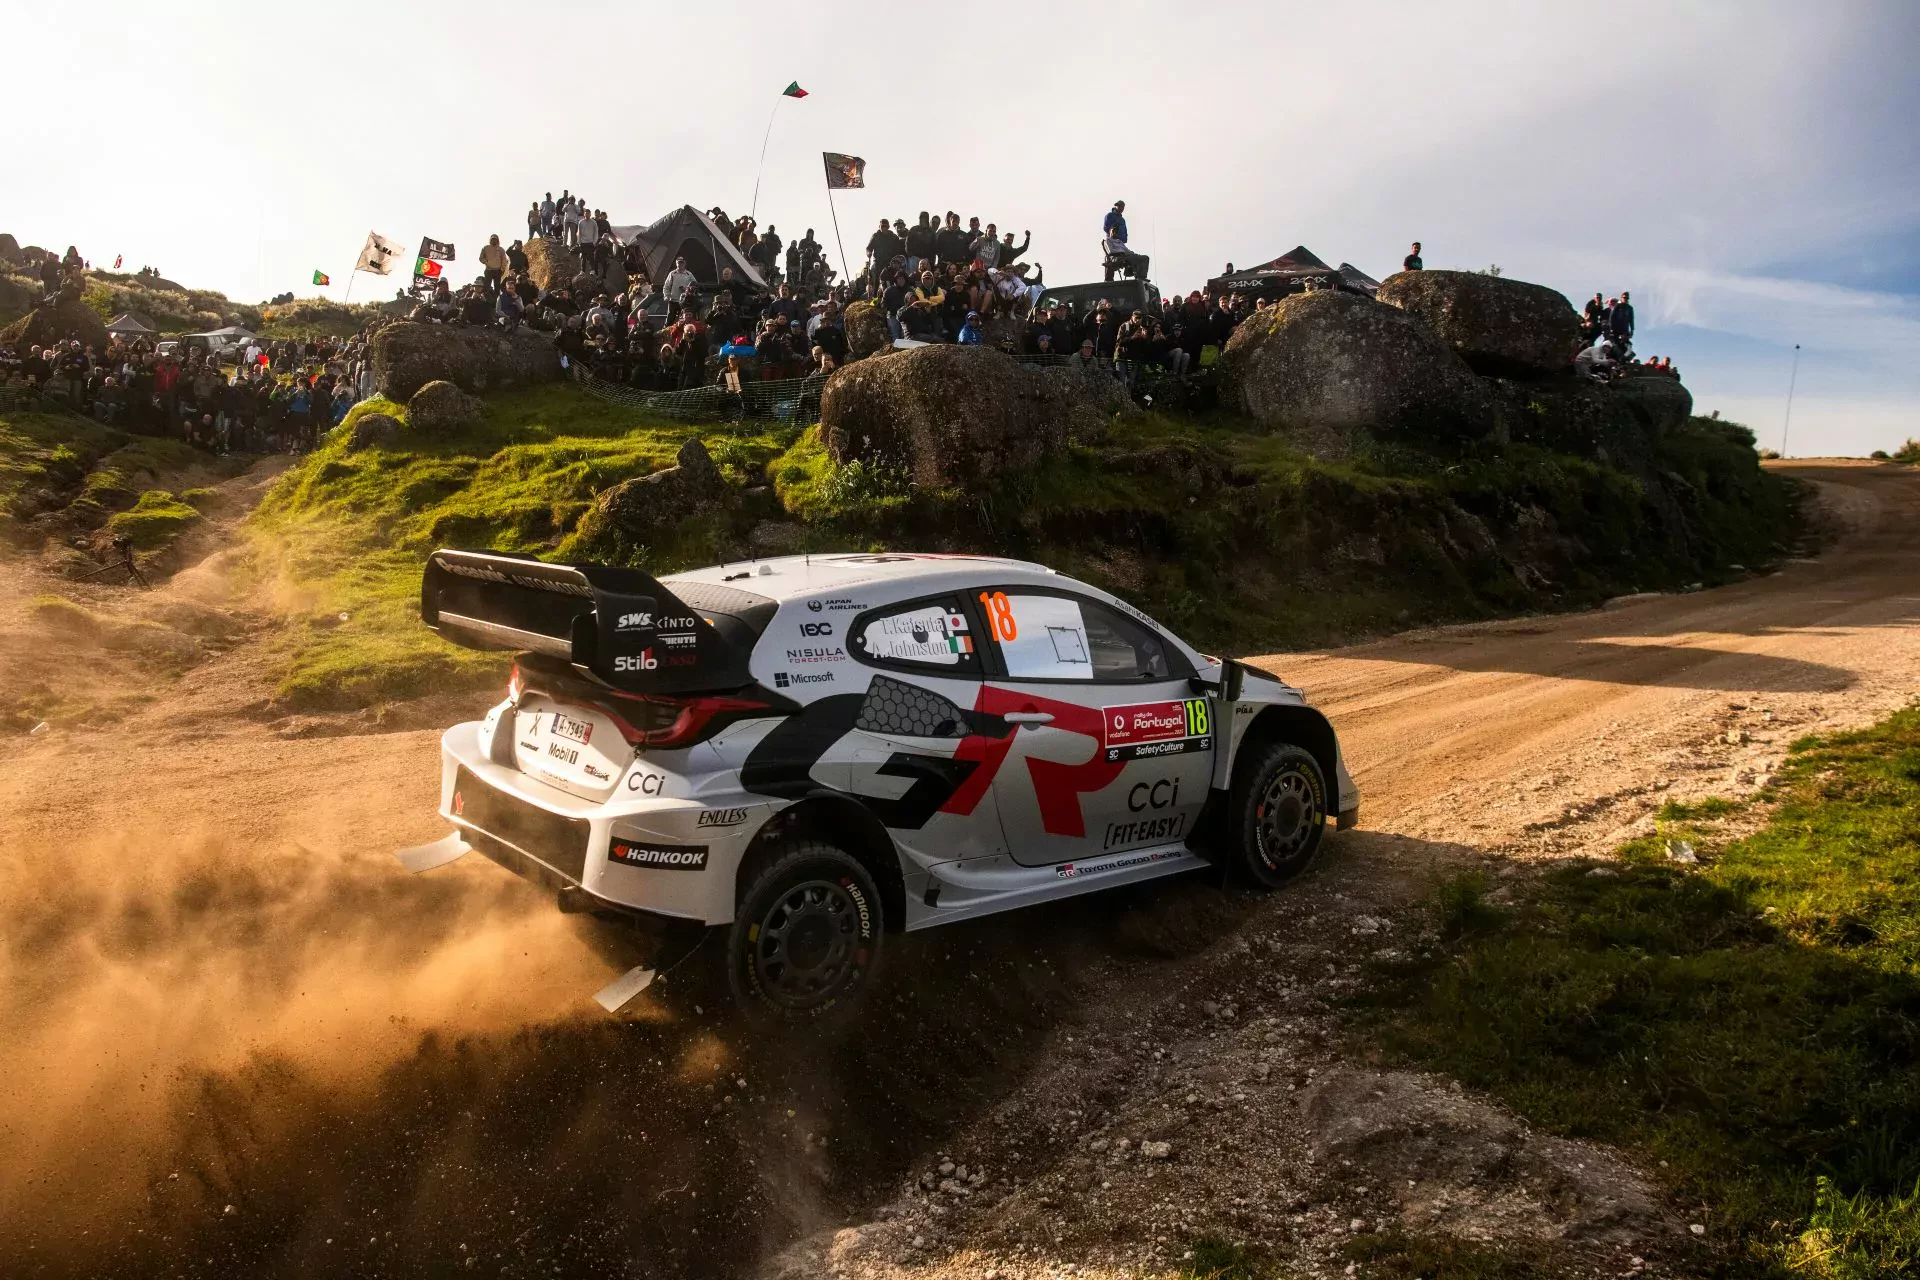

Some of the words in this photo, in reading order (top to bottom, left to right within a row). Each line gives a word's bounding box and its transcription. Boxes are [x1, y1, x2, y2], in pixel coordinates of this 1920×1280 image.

[828, 603, 868, 611] AIRLINES
[617, 612, 656, 629] SWS
[979, 591, 1017, 642] 18
[614, 646, 658, 673] Stilo
[787, 647, 844, 659] NISULA
[790, 671, 835, 685] Microsoft
[1133, 714, 1184, 729] Portugal
[1185, 700, 1208, 735] 18
[548, 742, 571, 763] Mobil
[1136, 742, 1185, 756] SafetyCulture
[697, 807, 748, 826] ENDLESS
[1076, 863, 1116, 875] TOYOTA
[1116, 856, 1150, 867] GAZOO
[1150, 850, 1182, 862] Racing
